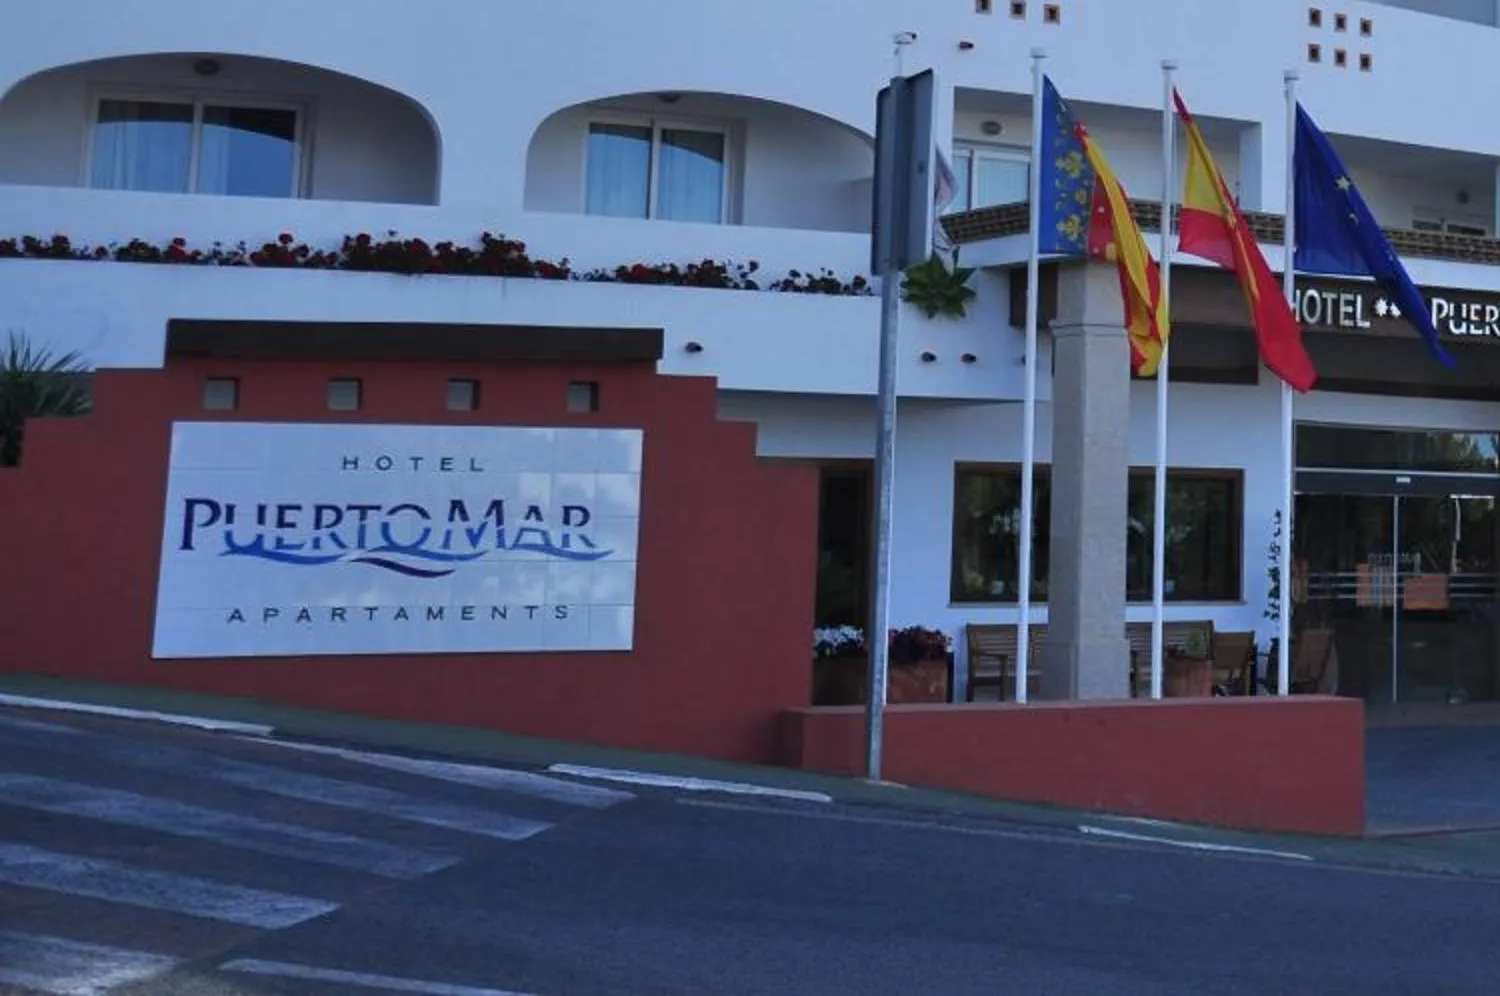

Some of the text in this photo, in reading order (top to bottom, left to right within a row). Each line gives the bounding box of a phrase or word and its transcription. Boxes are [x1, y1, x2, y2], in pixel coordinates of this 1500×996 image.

[343, 455, 484, 473] HOTEL
[179, 497, 597, 551] PUERTOMAR
[228, 604, 570, 624] APARTAMENTS
